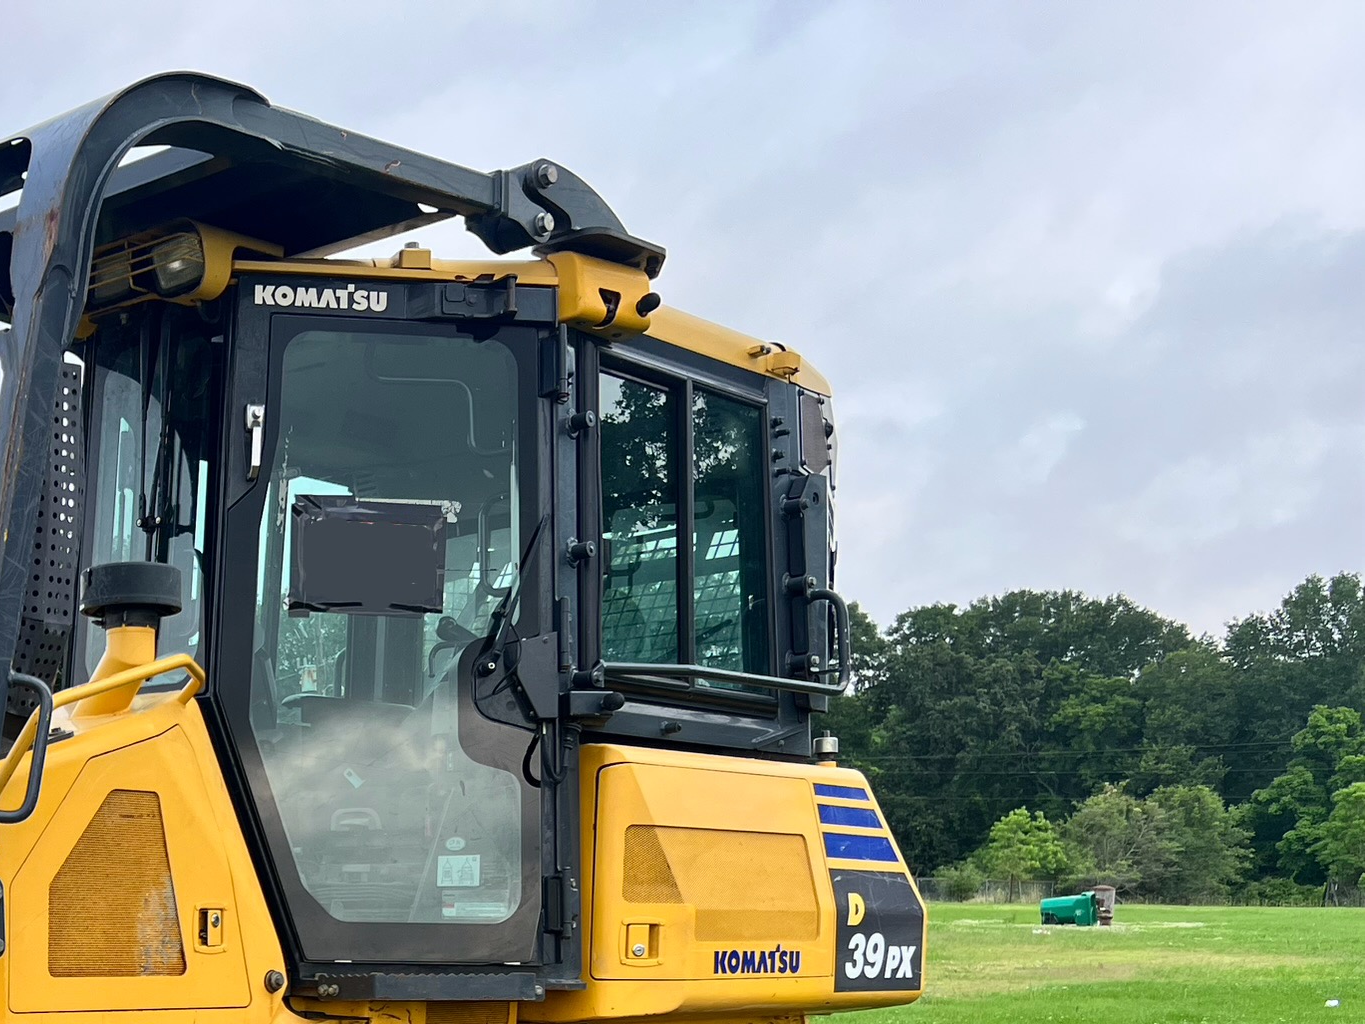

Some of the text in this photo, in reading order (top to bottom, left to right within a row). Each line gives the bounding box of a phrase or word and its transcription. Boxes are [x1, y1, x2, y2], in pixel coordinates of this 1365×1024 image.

[254, 283, 388, 312] KOMATSU
[846, 892, 866, 926] D
[713, 943, 801, 975] KOMATSU
[844, 932, 917, 980] 39PX
